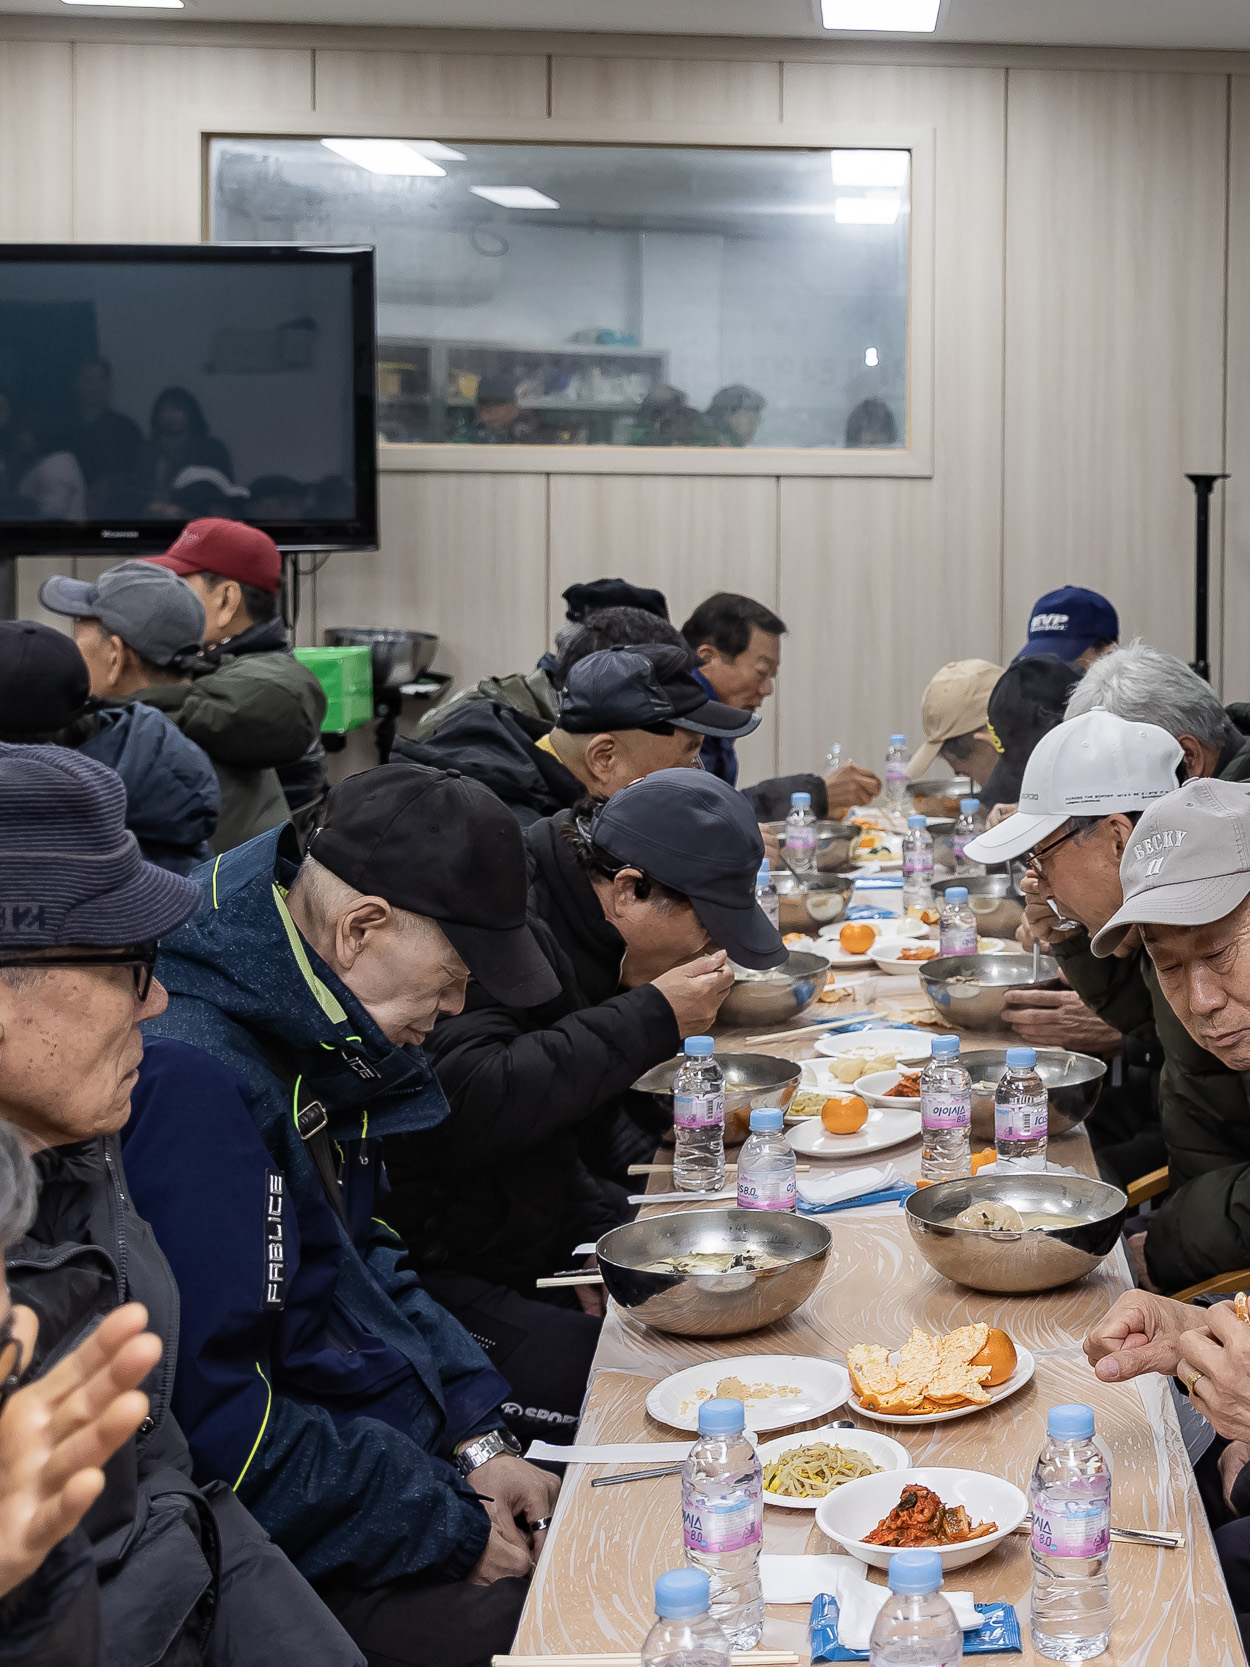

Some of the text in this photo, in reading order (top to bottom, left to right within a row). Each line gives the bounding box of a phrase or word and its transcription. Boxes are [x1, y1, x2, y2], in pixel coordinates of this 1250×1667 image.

[1132, 830, 1187, 861] BECKY
[690, 1530, 703, 1543] 8.0
[1039, 1534, 1052, 1547] 8.0
